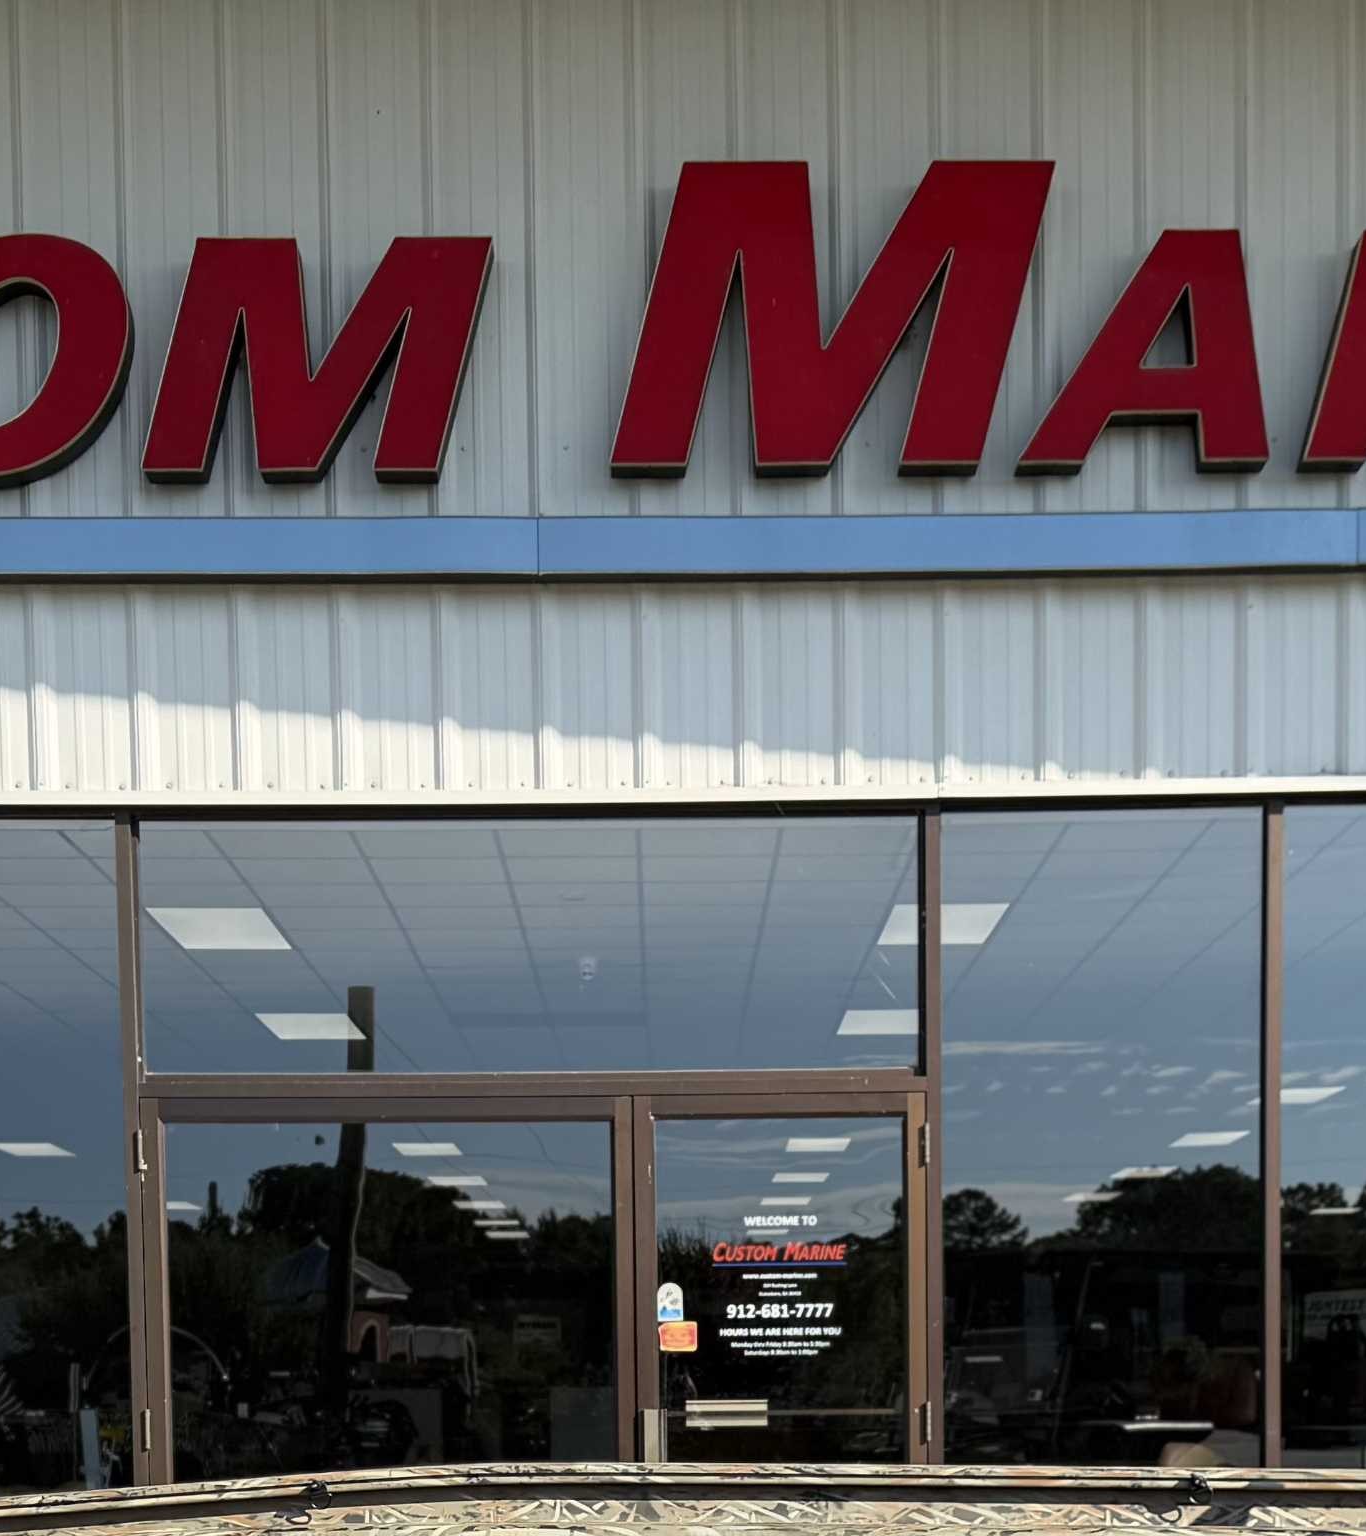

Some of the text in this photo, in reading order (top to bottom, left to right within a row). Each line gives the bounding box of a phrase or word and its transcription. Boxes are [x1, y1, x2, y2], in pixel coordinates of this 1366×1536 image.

[743, 1215, 817, 1226] WELCOME TO
[712, 1241, 847, 1262] CUSTOM MARINE
[726, 1303, 834, 1319] 912-681-7777
[719, 1327, 842, 1337] HOURS WE ARE HERE FOR YOU
